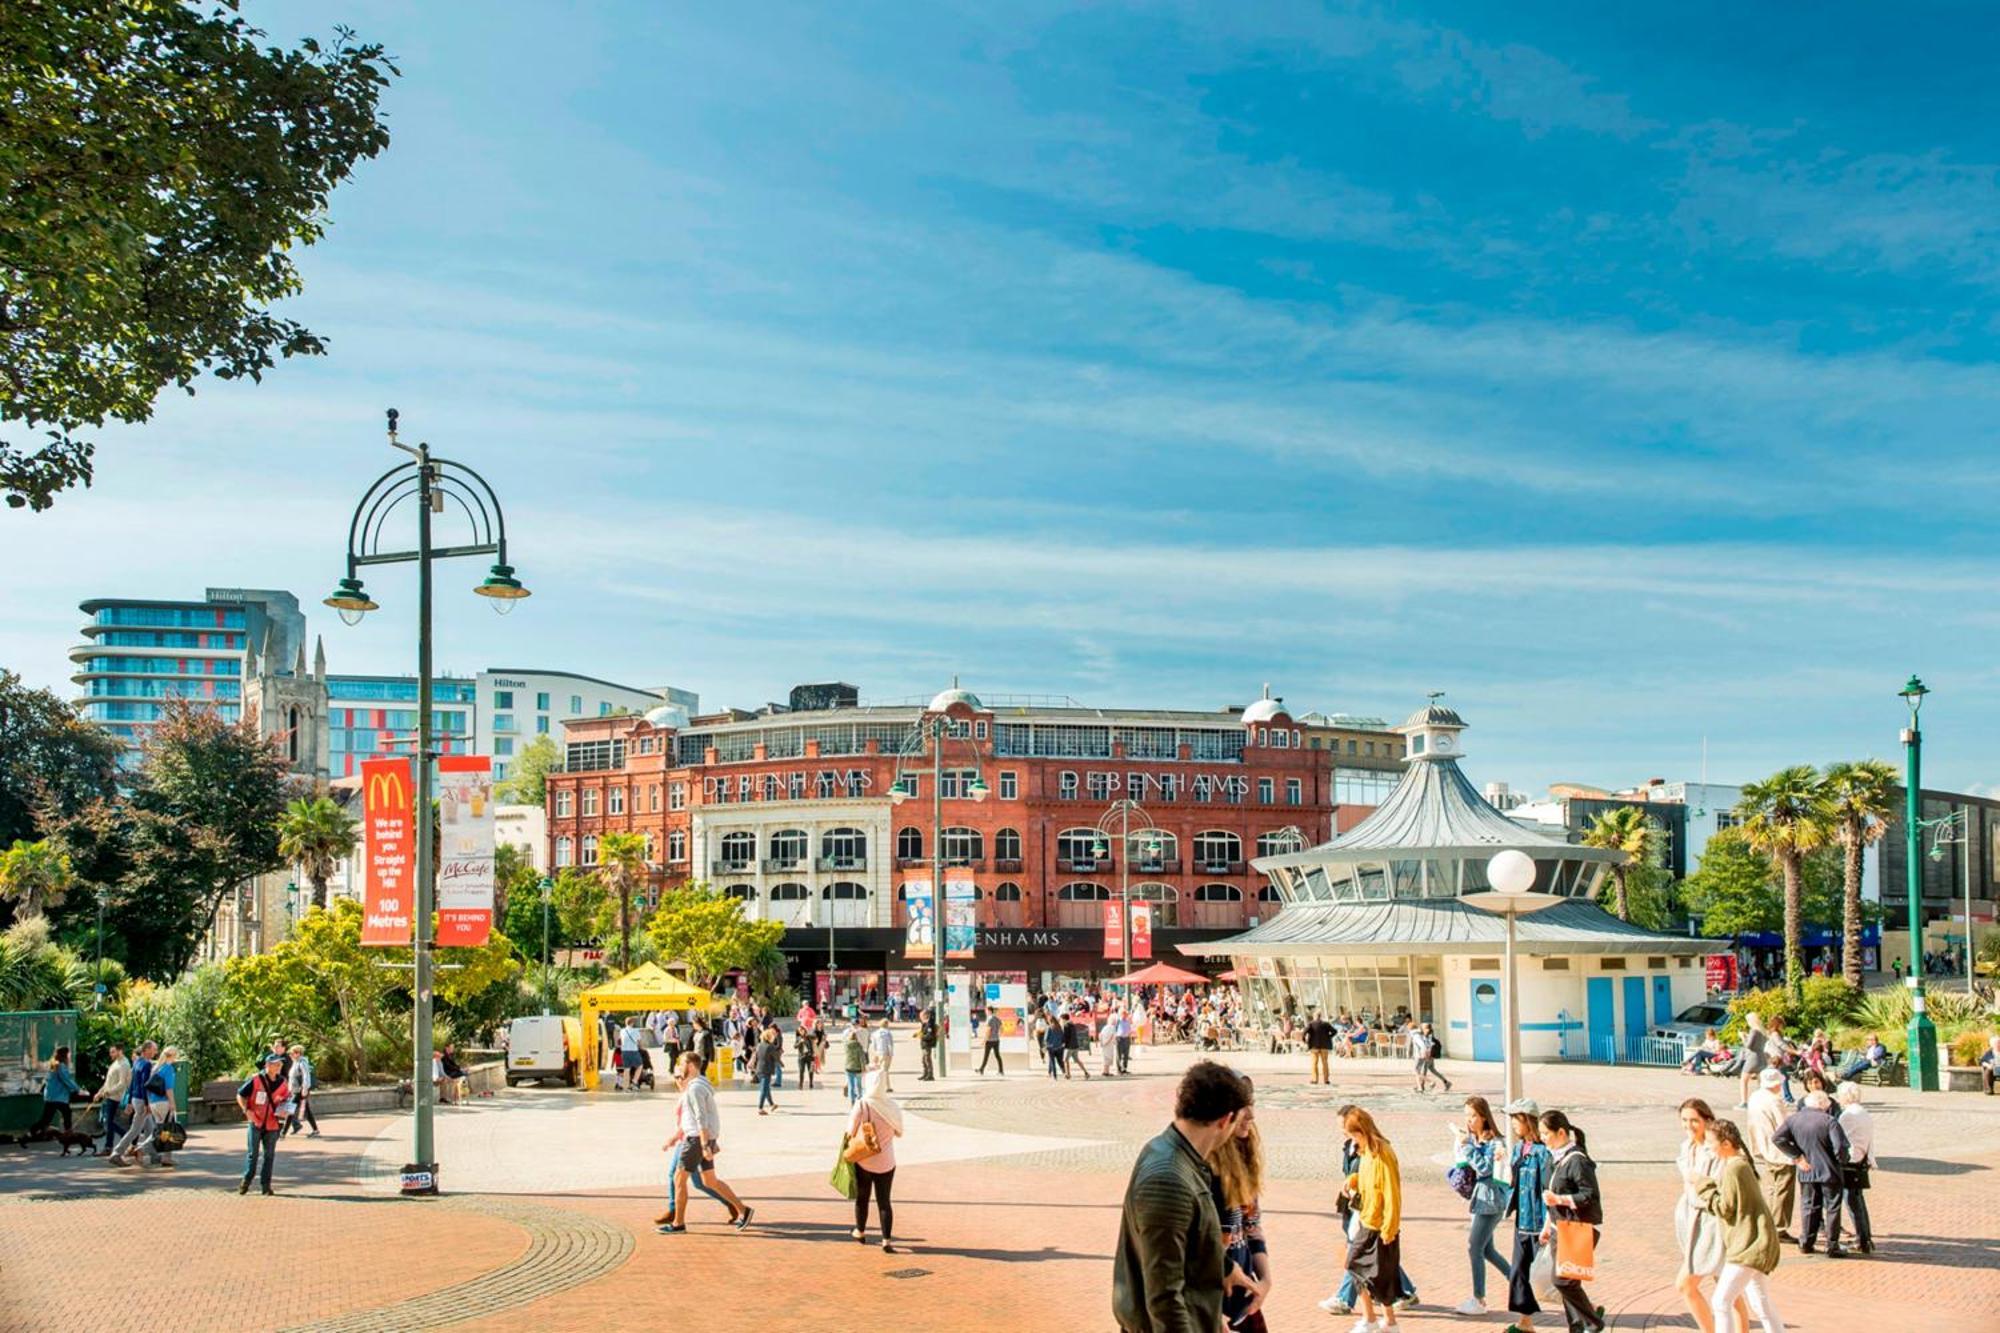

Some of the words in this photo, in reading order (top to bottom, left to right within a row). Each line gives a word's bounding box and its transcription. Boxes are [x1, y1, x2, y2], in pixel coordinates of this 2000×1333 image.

[494, 679, 526, 688] Hilton
[703, 768, 873, 795] DEBENHAMS
[1061, 770, 1250, 795] DEBENHAMS
[375, 818, 388, 828] We
[389, 819, 403, 828] are
[375, 830, 403, 840] behind
[382, 842, 398, 853] you
[374, 854, 406, 866] Straight
[379, 898, 400, 912] 100
[368, 914, 408, 928] Metres
[458, 913, 486, 922] BEHIND
[456, 923, 472, 932] YOU
